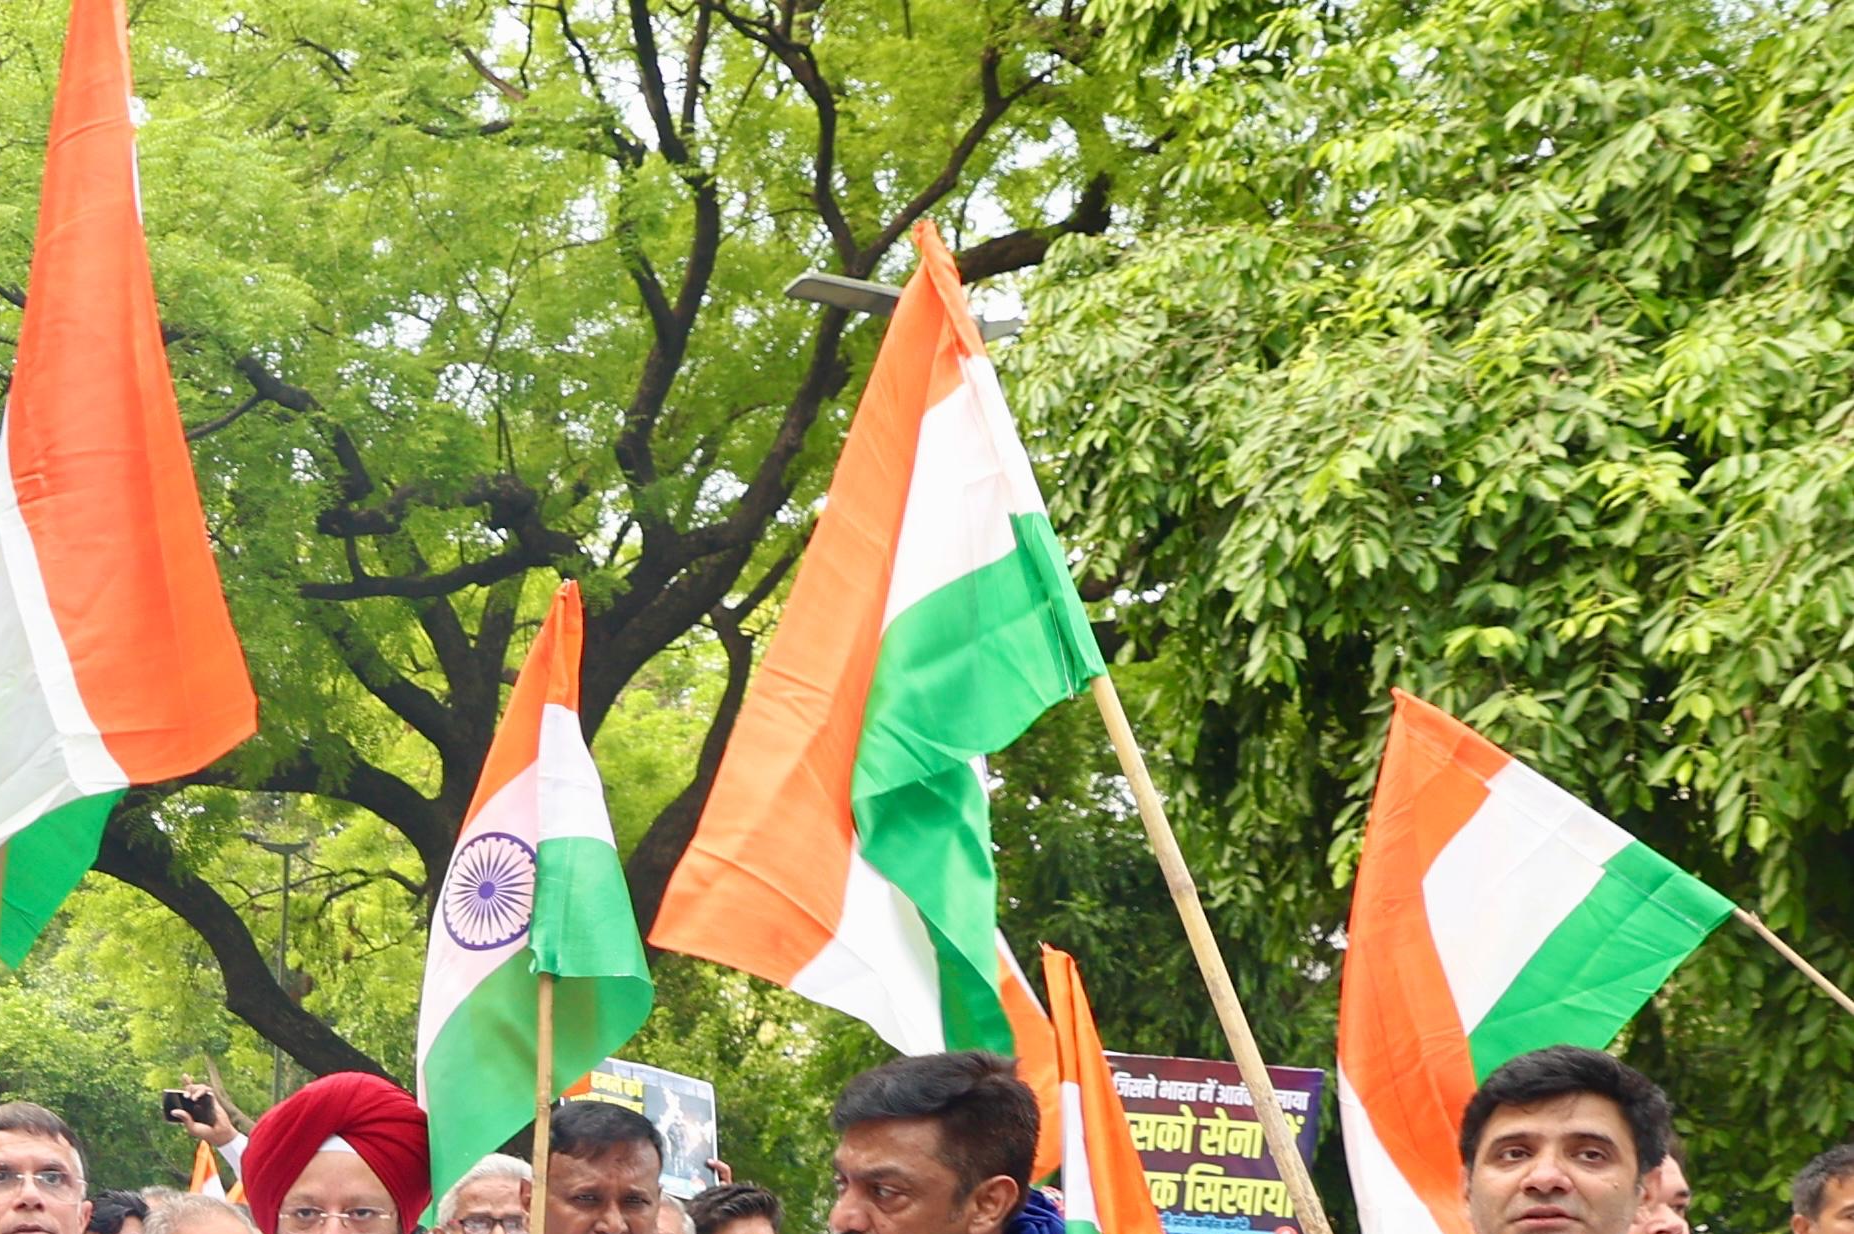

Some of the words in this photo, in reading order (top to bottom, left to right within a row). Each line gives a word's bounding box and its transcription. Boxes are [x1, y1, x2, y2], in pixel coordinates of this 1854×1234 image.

[1112, 1071, 1158, 1099] जिसने
[1158, 1080, 1199, 1102] भारत
[1198, 1077, 1219, 1103] में
[1123, 1103, 1198, 1154] सको
[1199, 1106, 1264, 1159] सेना
[1183, 1162, 1294, 1218] सिखाया
